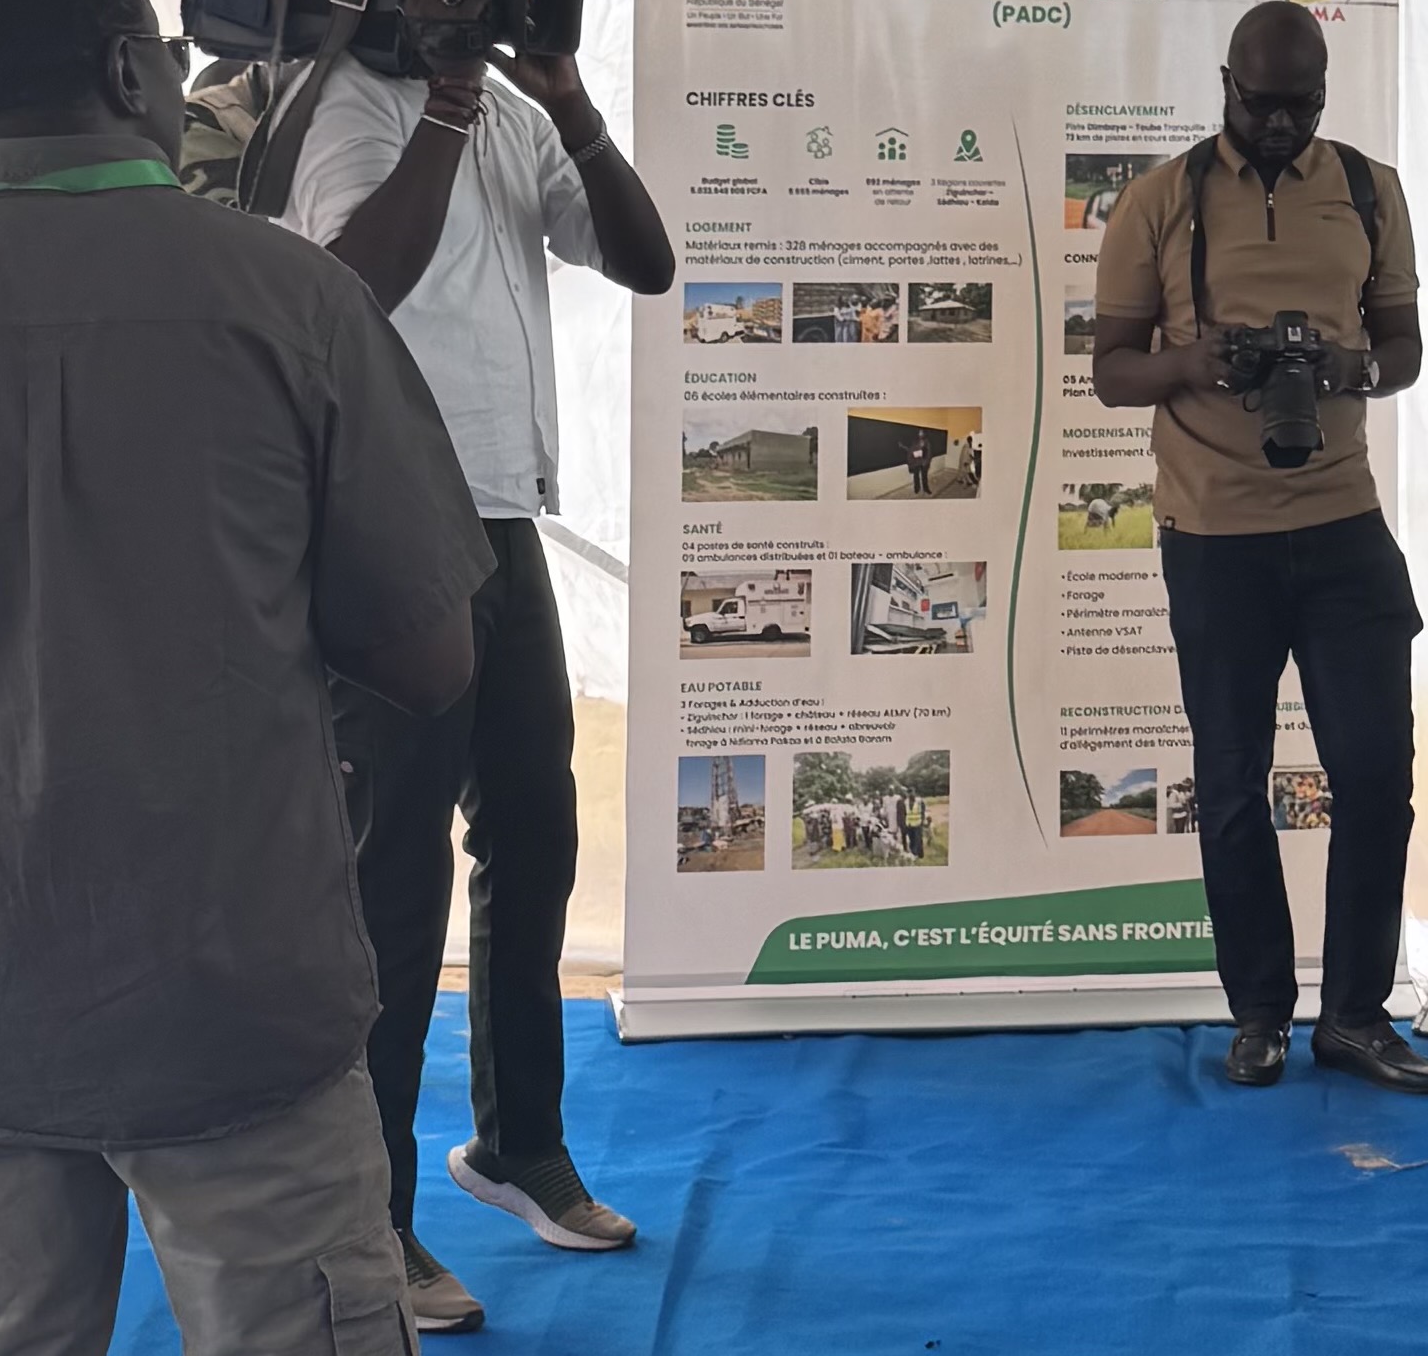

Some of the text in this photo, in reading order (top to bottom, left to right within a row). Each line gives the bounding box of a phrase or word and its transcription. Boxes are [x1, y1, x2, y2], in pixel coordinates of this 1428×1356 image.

[992, 1, 1071, 28] (PADC)
[1314, 6, 1346, 21] MA
[686, 89, 815, 107] CHIFFRES CLÉS
[1066, 103, 1176, 116] DÉSENCLAVEMENT
[685, 222, 752, 232] LOGEMENT
[685, 240, 999, 255] Matériaux remis ménages accompagnés avec des
[685, 254, 924, 267] matériaux de construction portes
[1064, 254, 1098, 263] CONN
[684, 371, 757, 384] ÉDUCATION
[701, 390, 880, 401] écoles élémentaires construites
[1063, 428, 1152, 439] MODERNISATIO
[1062, 449, 1144, 458] Investissement
[683, 521, 723, 534] SANTÉ
[697, 539, 825, 552] postes de santé construits
[697, 549, 943, 562] ambulances distribuées bateau ambulance
[1067, 570, 1149, 581] École moderne
[1067, 591, 1105, 602] Forage
[1067, 608, 1120, 619] Périmètre
[1067, 626, 1143, 637] Antenne VSAT
[1066, 645, 1093, 656] Piste
[681, 681, 762, 693] EAU POTABLE
[1060, 705, 1171, 717] RECONSTRUCTION
[789, 915, 1214, 950] LE PUMA, C'EST L'ÉQUITÉ SANS FRONTIÈ
